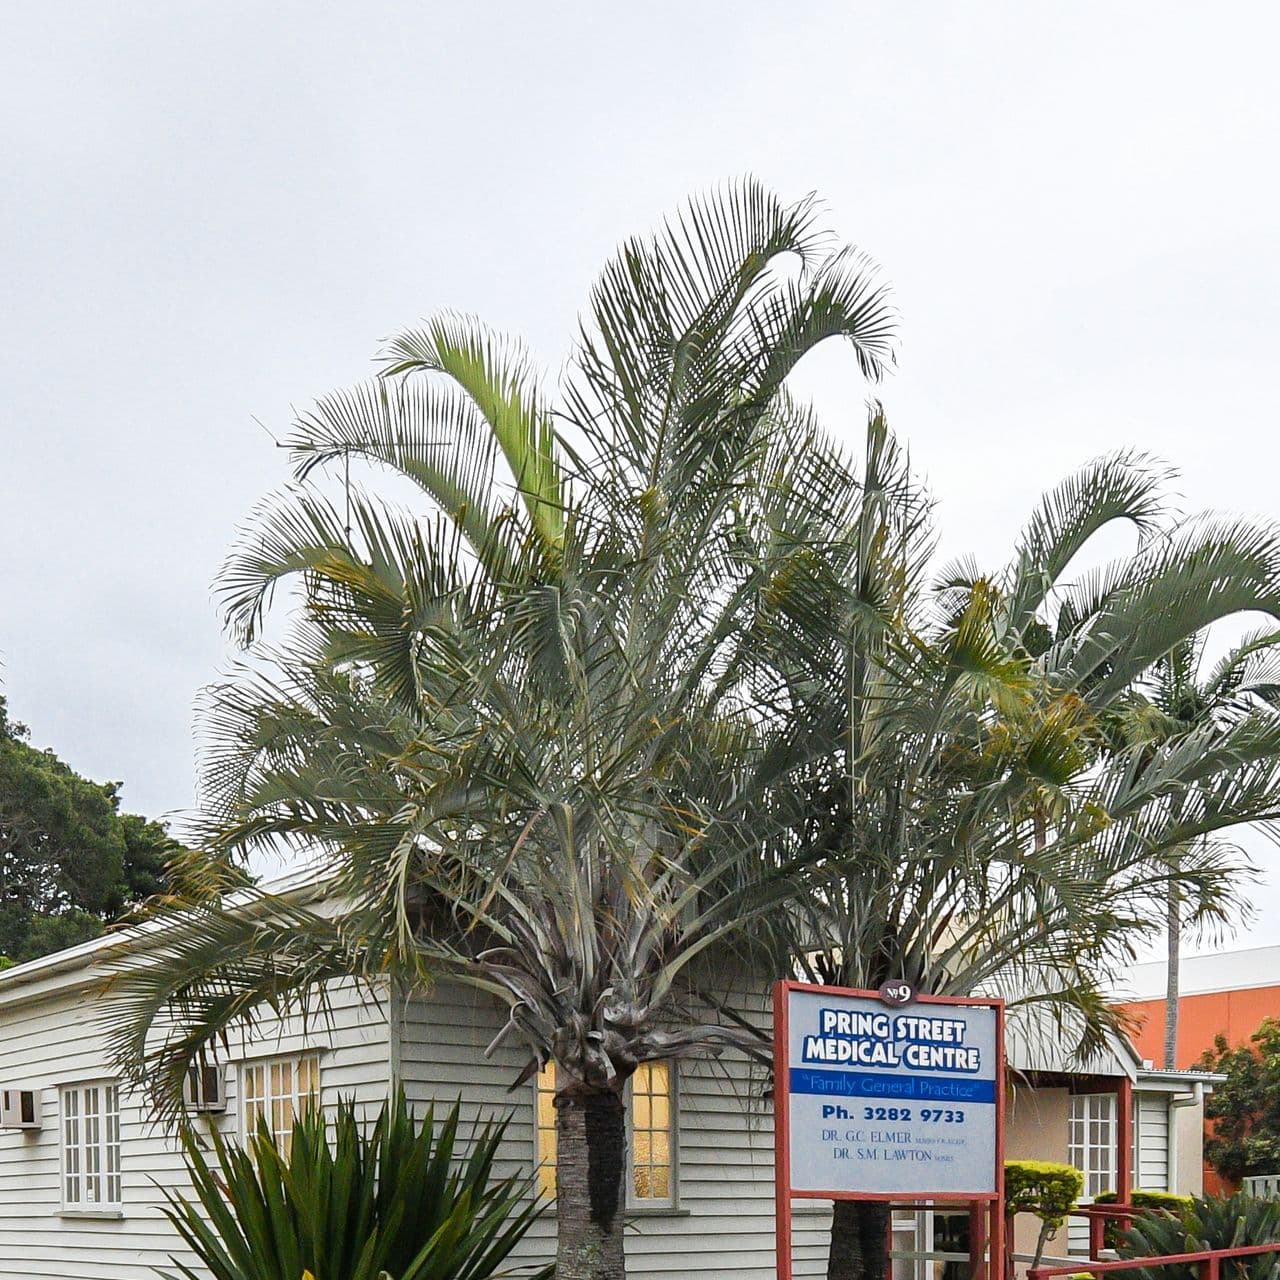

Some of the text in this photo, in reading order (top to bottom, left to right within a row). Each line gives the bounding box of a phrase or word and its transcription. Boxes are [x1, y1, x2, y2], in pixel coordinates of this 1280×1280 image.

[823, 1010, 966, 1042] PRING STREET
[805, 1037, 980, 1070] MEDICAL CENTRE
[861, 1078, 915, 1094] General
[822, 1105, 964, 1123] Ph. 3282 9733
[870, 1131, 912, 1144] ELMER
[884, 1149, 932, 1161] LAWTON
